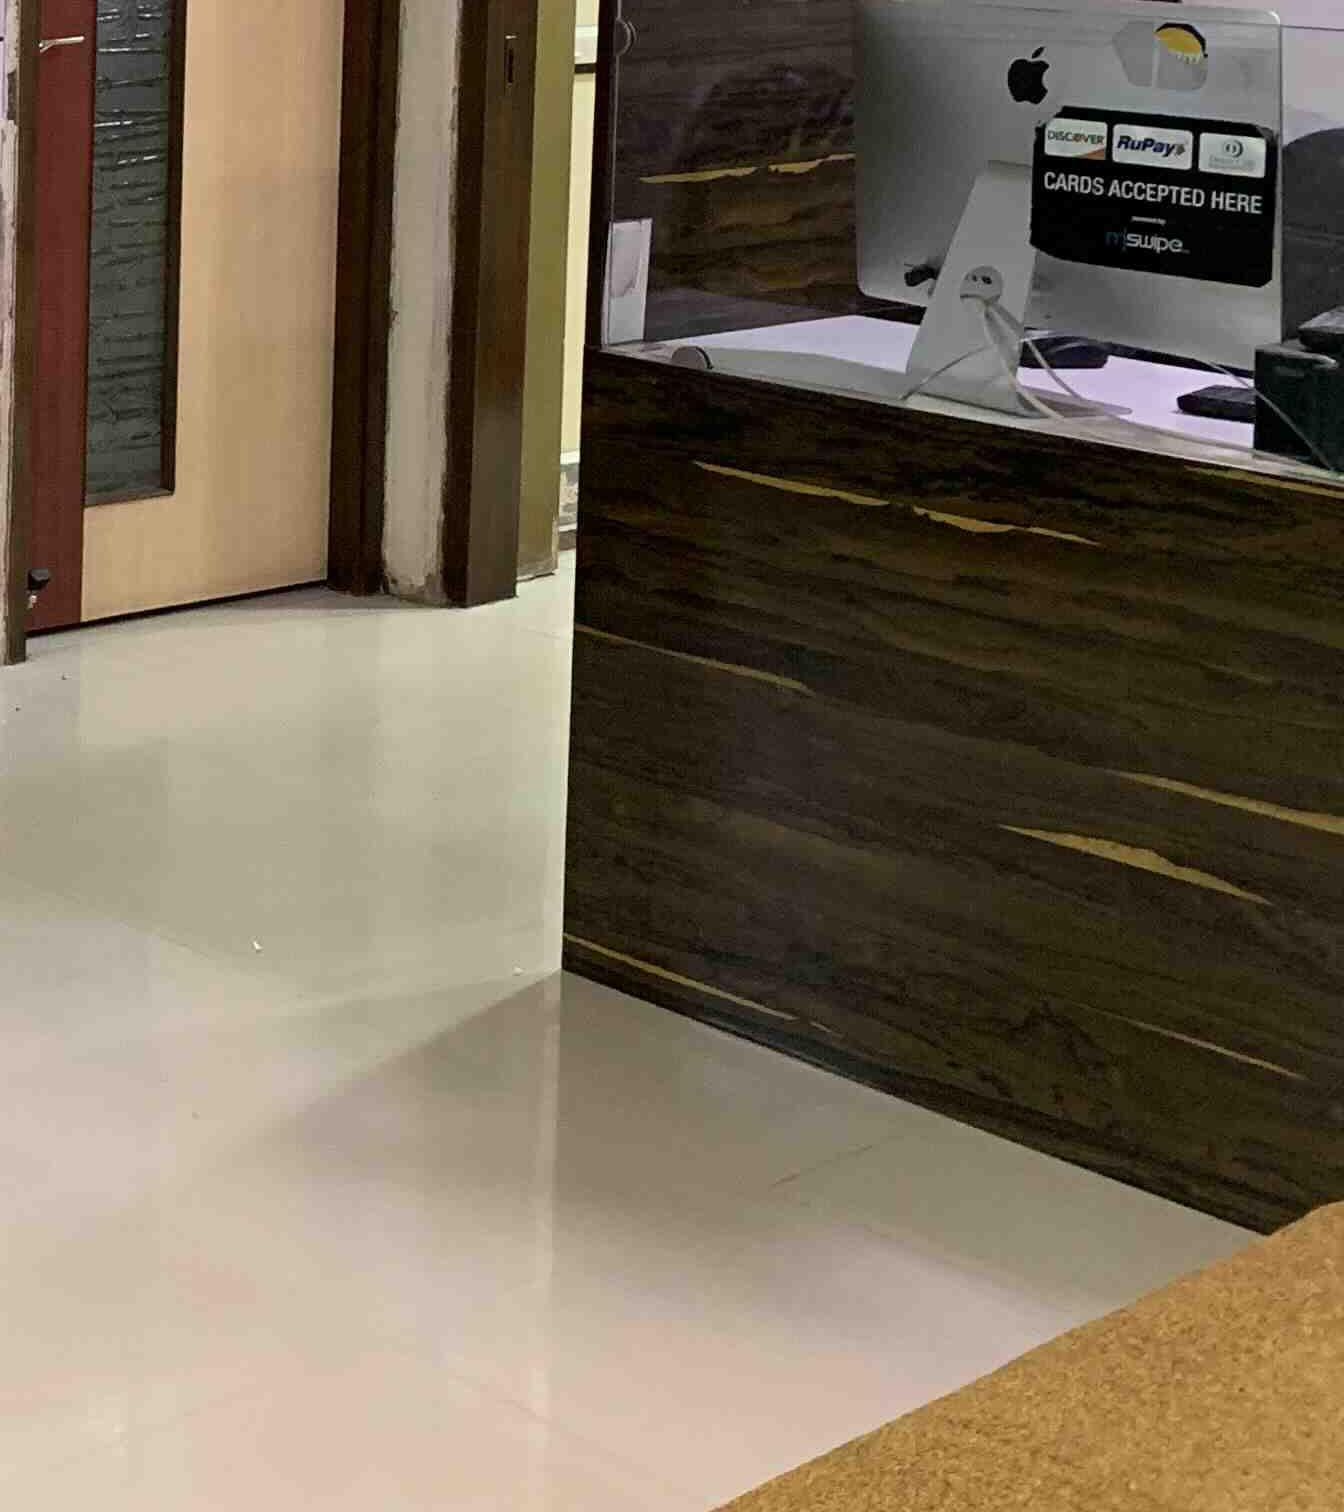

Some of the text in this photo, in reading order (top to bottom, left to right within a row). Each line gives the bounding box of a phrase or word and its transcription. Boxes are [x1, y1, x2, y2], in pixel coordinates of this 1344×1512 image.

[1047, 129, 1104, 146] DISCOVER
[1116, 135, 1175, 157] RuPay
[1044, 171, 1262, 214] CARDS ACCEPTED HERE
